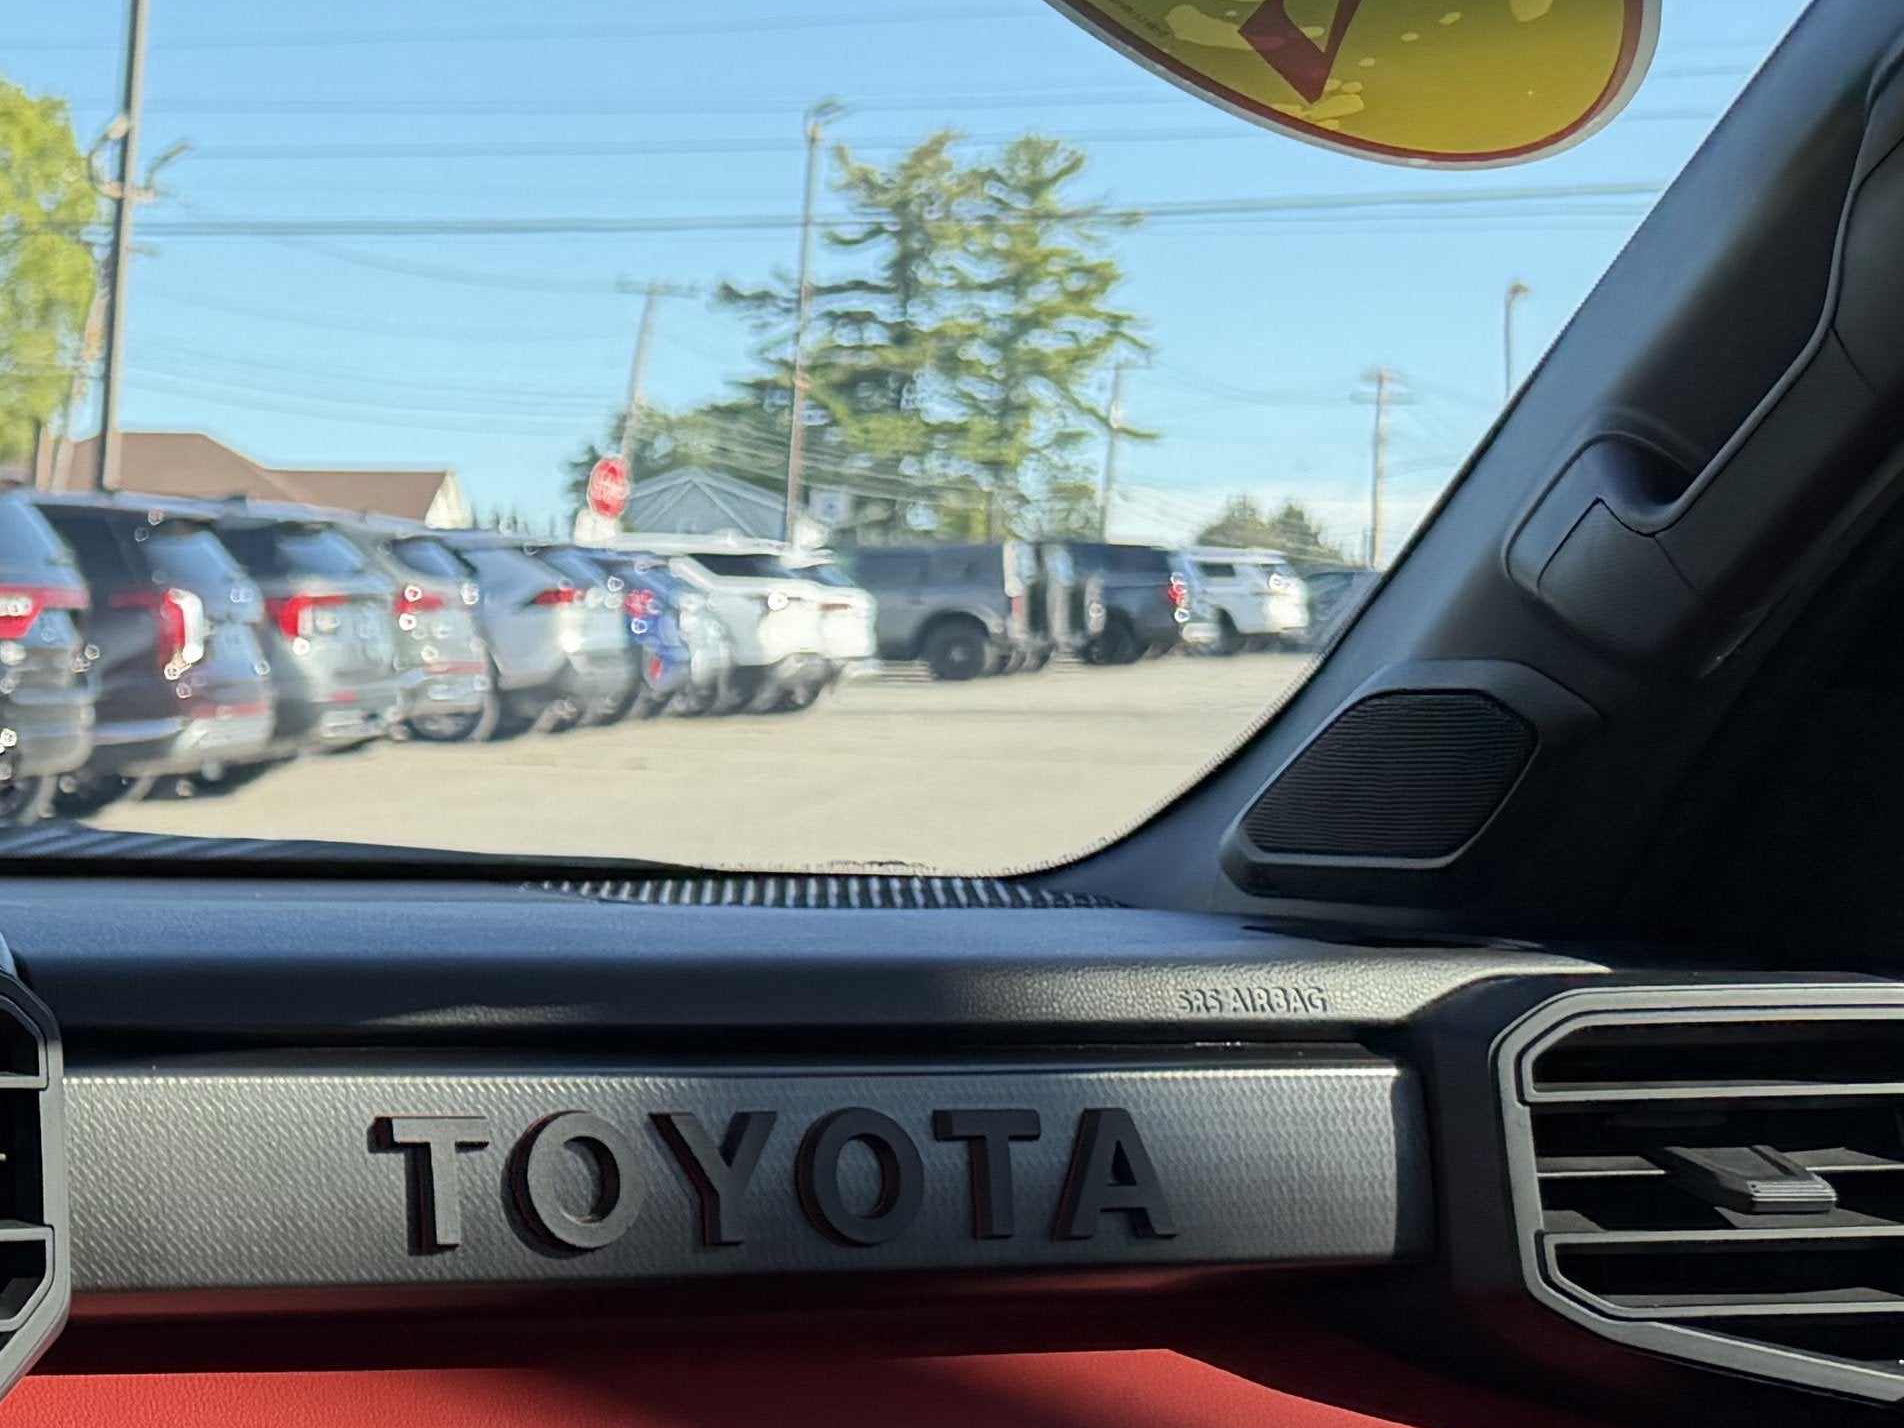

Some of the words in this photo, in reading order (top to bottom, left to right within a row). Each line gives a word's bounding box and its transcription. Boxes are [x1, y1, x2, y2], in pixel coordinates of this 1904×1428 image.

[1176, 987, 1224, 1013] SRS
[1230, 986, 1328, 1013] AIRBAG
[366, 1105, 1182, 1258] TOYOTA
